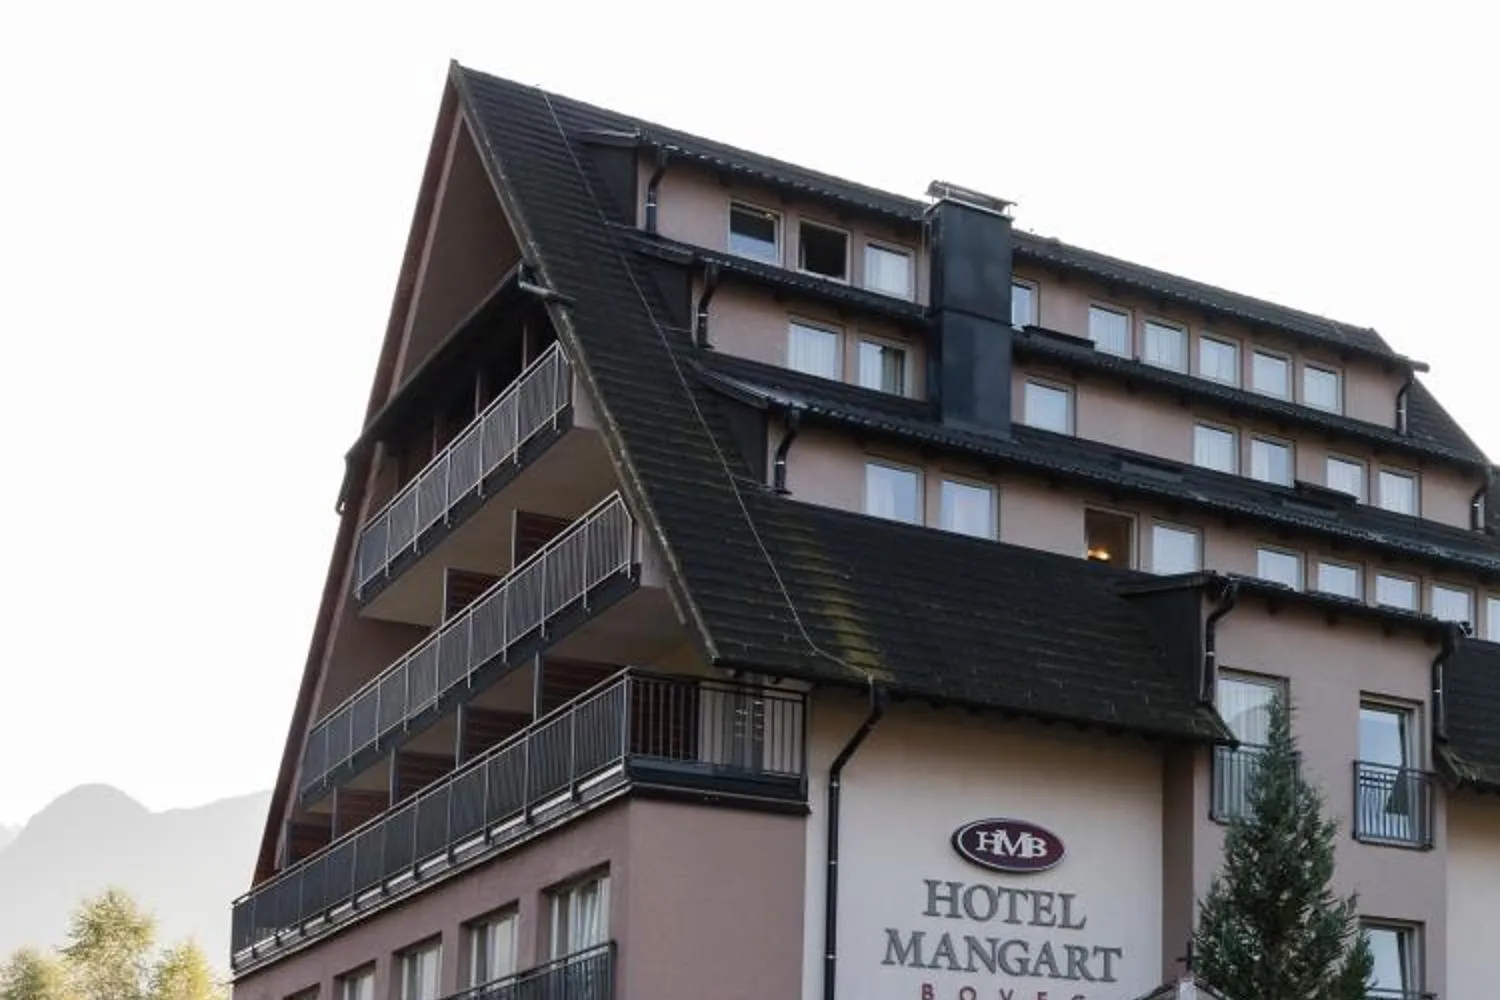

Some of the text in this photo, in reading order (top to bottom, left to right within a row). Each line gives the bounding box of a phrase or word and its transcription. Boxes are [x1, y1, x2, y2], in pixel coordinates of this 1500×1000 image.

[975, 829, 1047, 858] HMB
[922, 879, 1087, 930] HOTEL
[881, 928, 1122, 982] MANGART
